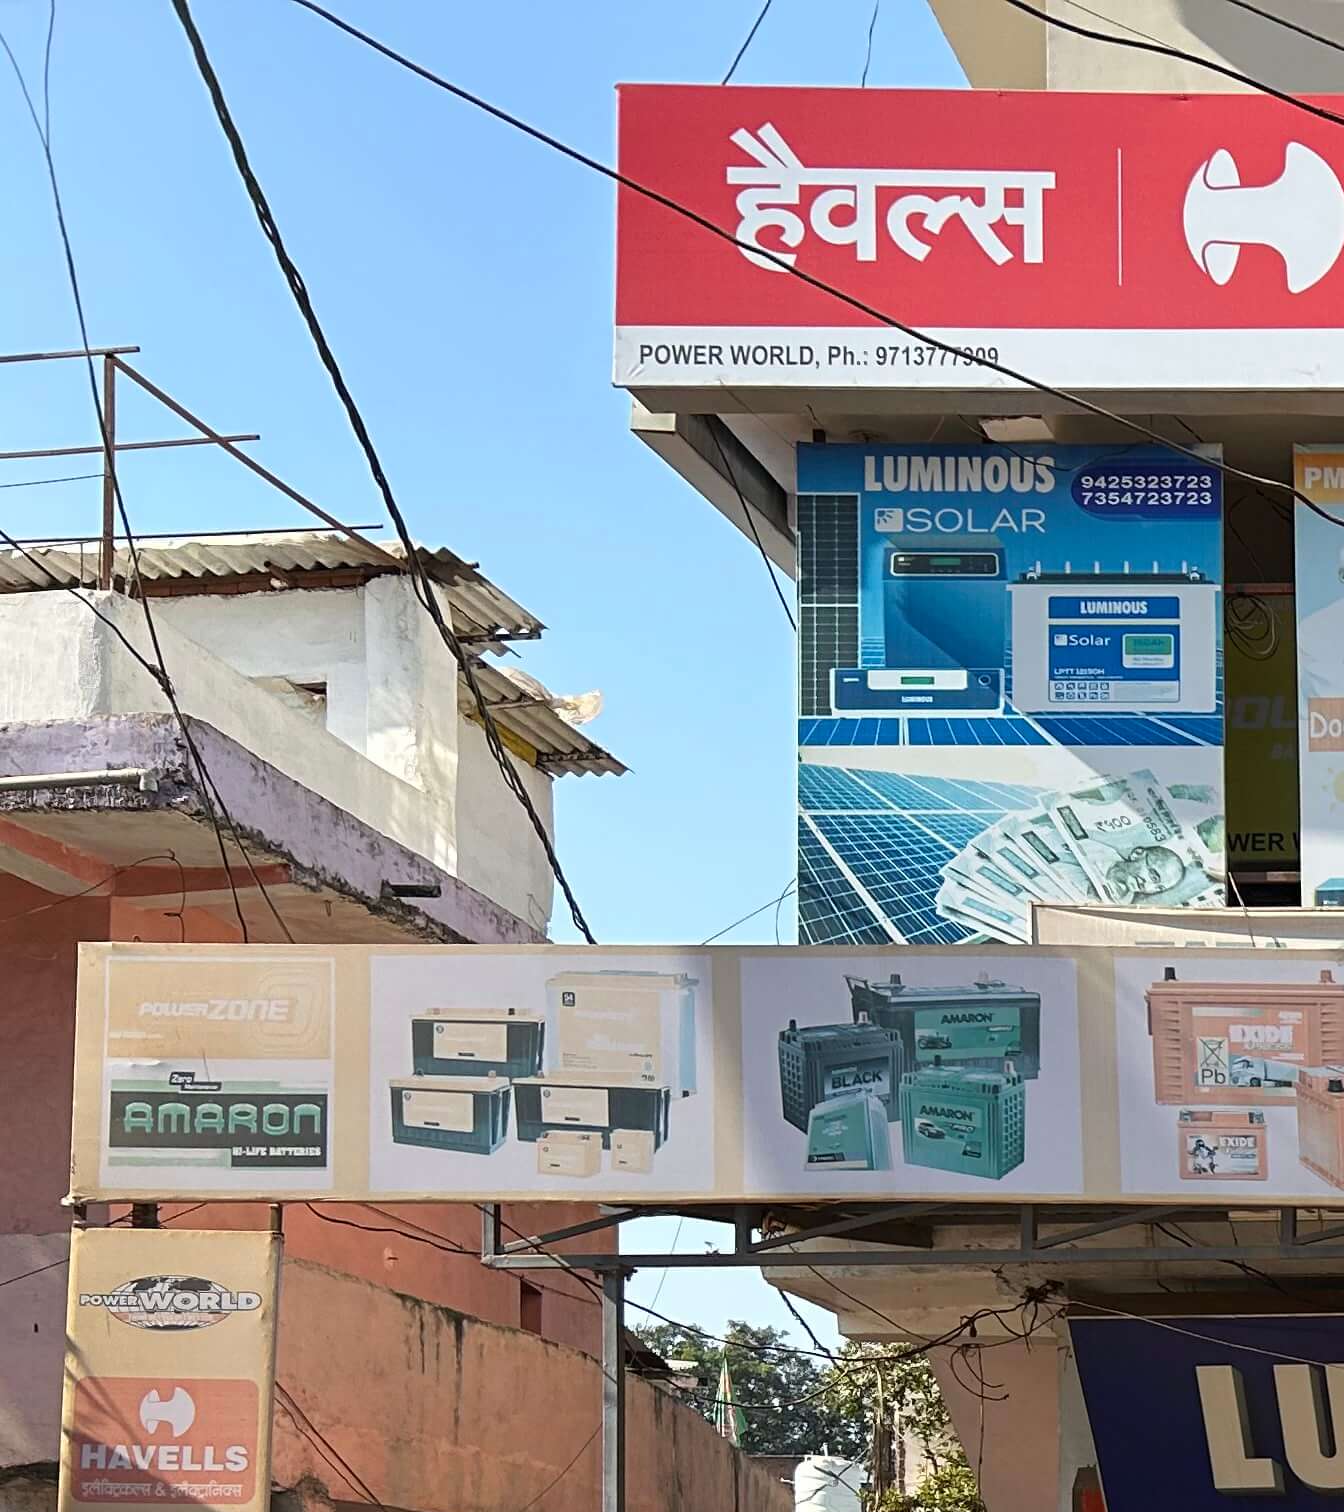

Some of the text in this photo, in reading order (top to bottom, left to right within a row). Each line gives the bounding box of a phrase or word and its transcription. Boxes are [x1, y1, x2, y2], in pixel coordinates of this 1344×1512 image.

[727, 122, 1056, 273] हैवल्स
[639, 345, 724, 367] POWER
[730, 345, 822, 370] WORLD,
[827, 345, 869, 367] Ph.:
[864, 456, 1056, 494] LUMINOUS
[1080, 475, 1213, 490] 9425323723
[1081, 491, 1213, 506] 7354723723
[905, 508, 1046, 533] SOLAR
[1080, 600, 1148, 615] LUMINOUS
[1068, 633, 1111, 647] Solar
[940, 1012, 994, 1025] AMARON
[831, 1069, 883, 1089] BLACK
[1201, 1068, 1227, 1085] Pb
[123, 1101, 322, 1136] AMARON
[919, 1105, 974, 1121] AMARON
[80, 1291, 262, 1311] POWER WORLD
[80, 1443, 249, 1472] HAVELLS
[154, 1482, 165, 1497] &
